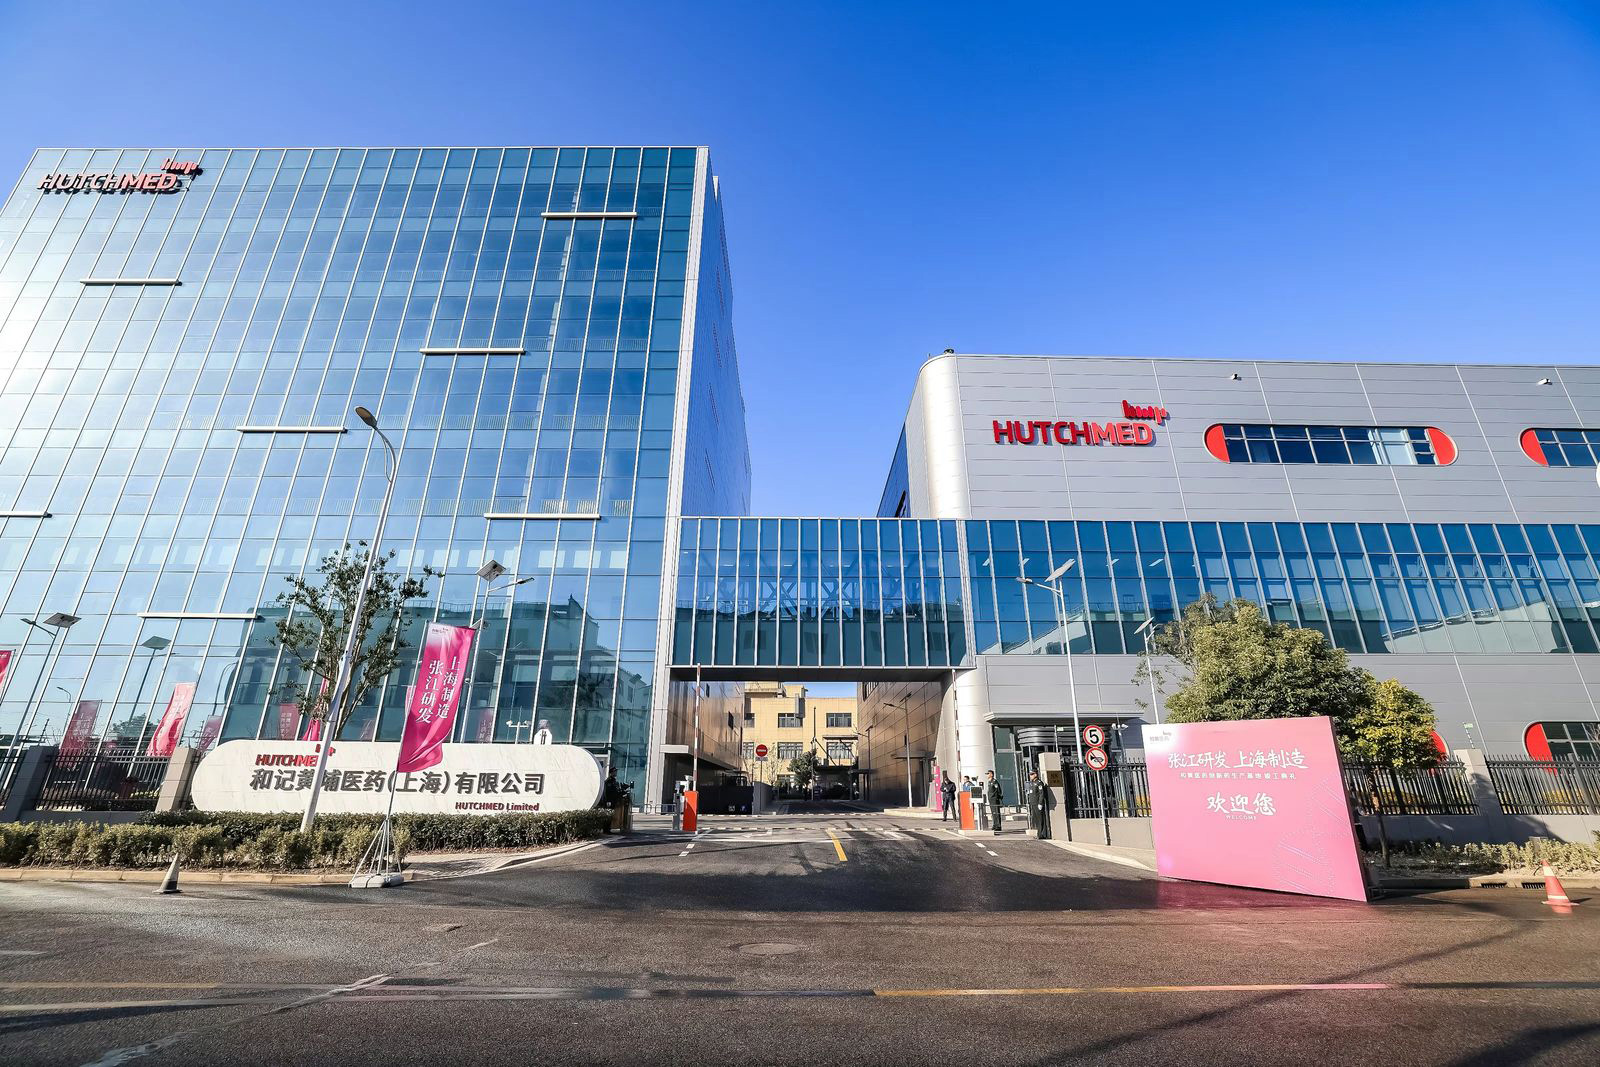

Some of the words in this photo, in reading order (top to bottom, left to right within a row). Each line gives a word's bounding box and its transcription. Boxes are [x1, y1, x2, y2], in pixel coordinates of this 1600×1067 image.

[38, 172, 178, 191] HUTCHMED
[992, 419, 1154, 446] HUTCHMED
[416, 659, 444, 724] 张江研发
[436, 656, 461, 719] 上海制造
[1089, 729, 1100, 744] 5
[255, 754, 319, 767] HUTCHME
[1167, 751, 1231, 769] 张江研发
[1233, 748, 1309, 769] 上海制造
[455, 802, 504, 811] HUTCHMED
[506, 802, 540, 812] Limited
[1207, 792, 1276, 816] 欢迎您
